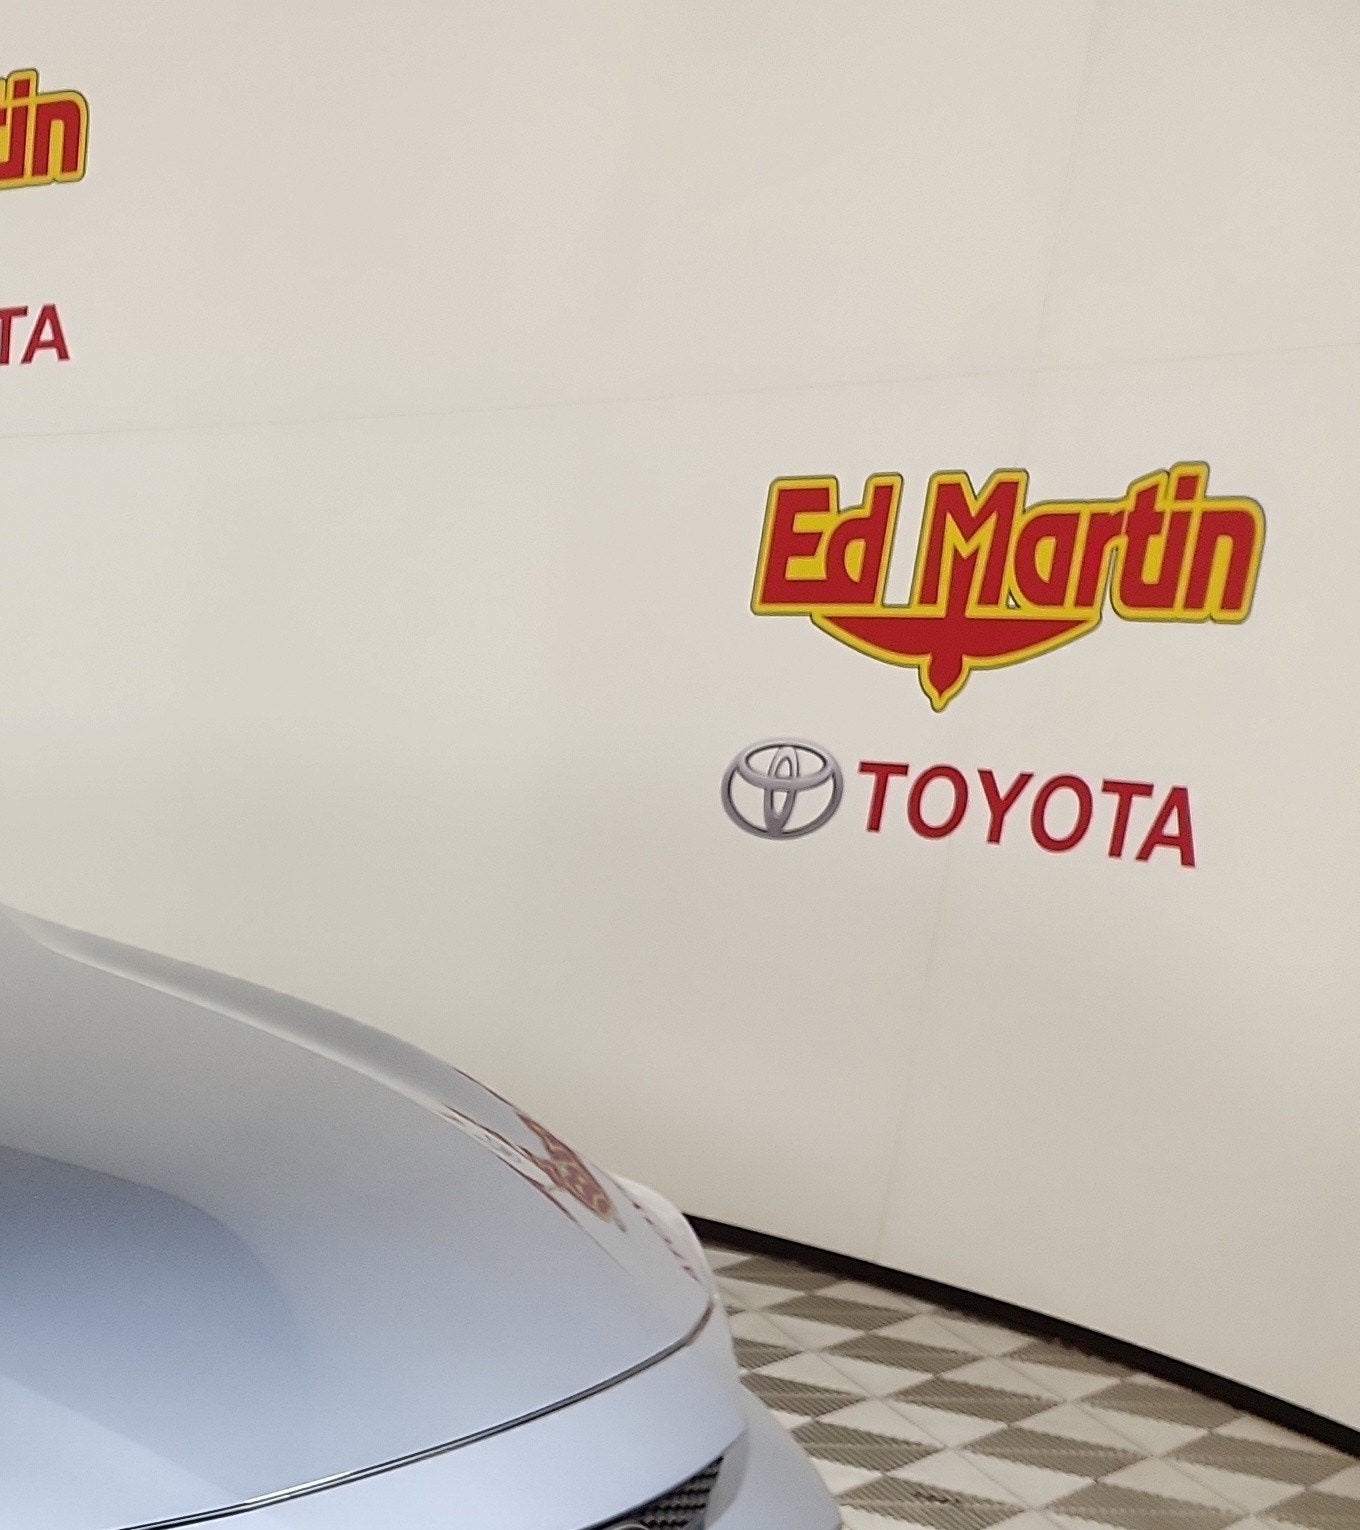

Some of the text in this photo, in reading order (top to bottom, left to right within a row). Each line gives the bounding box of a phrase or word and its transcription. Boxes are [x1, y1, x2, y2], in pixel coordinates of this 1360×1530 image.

[755, 468, 1259, 614] Ed Martin
[857, 760, 1197, 869] TOYOTA
